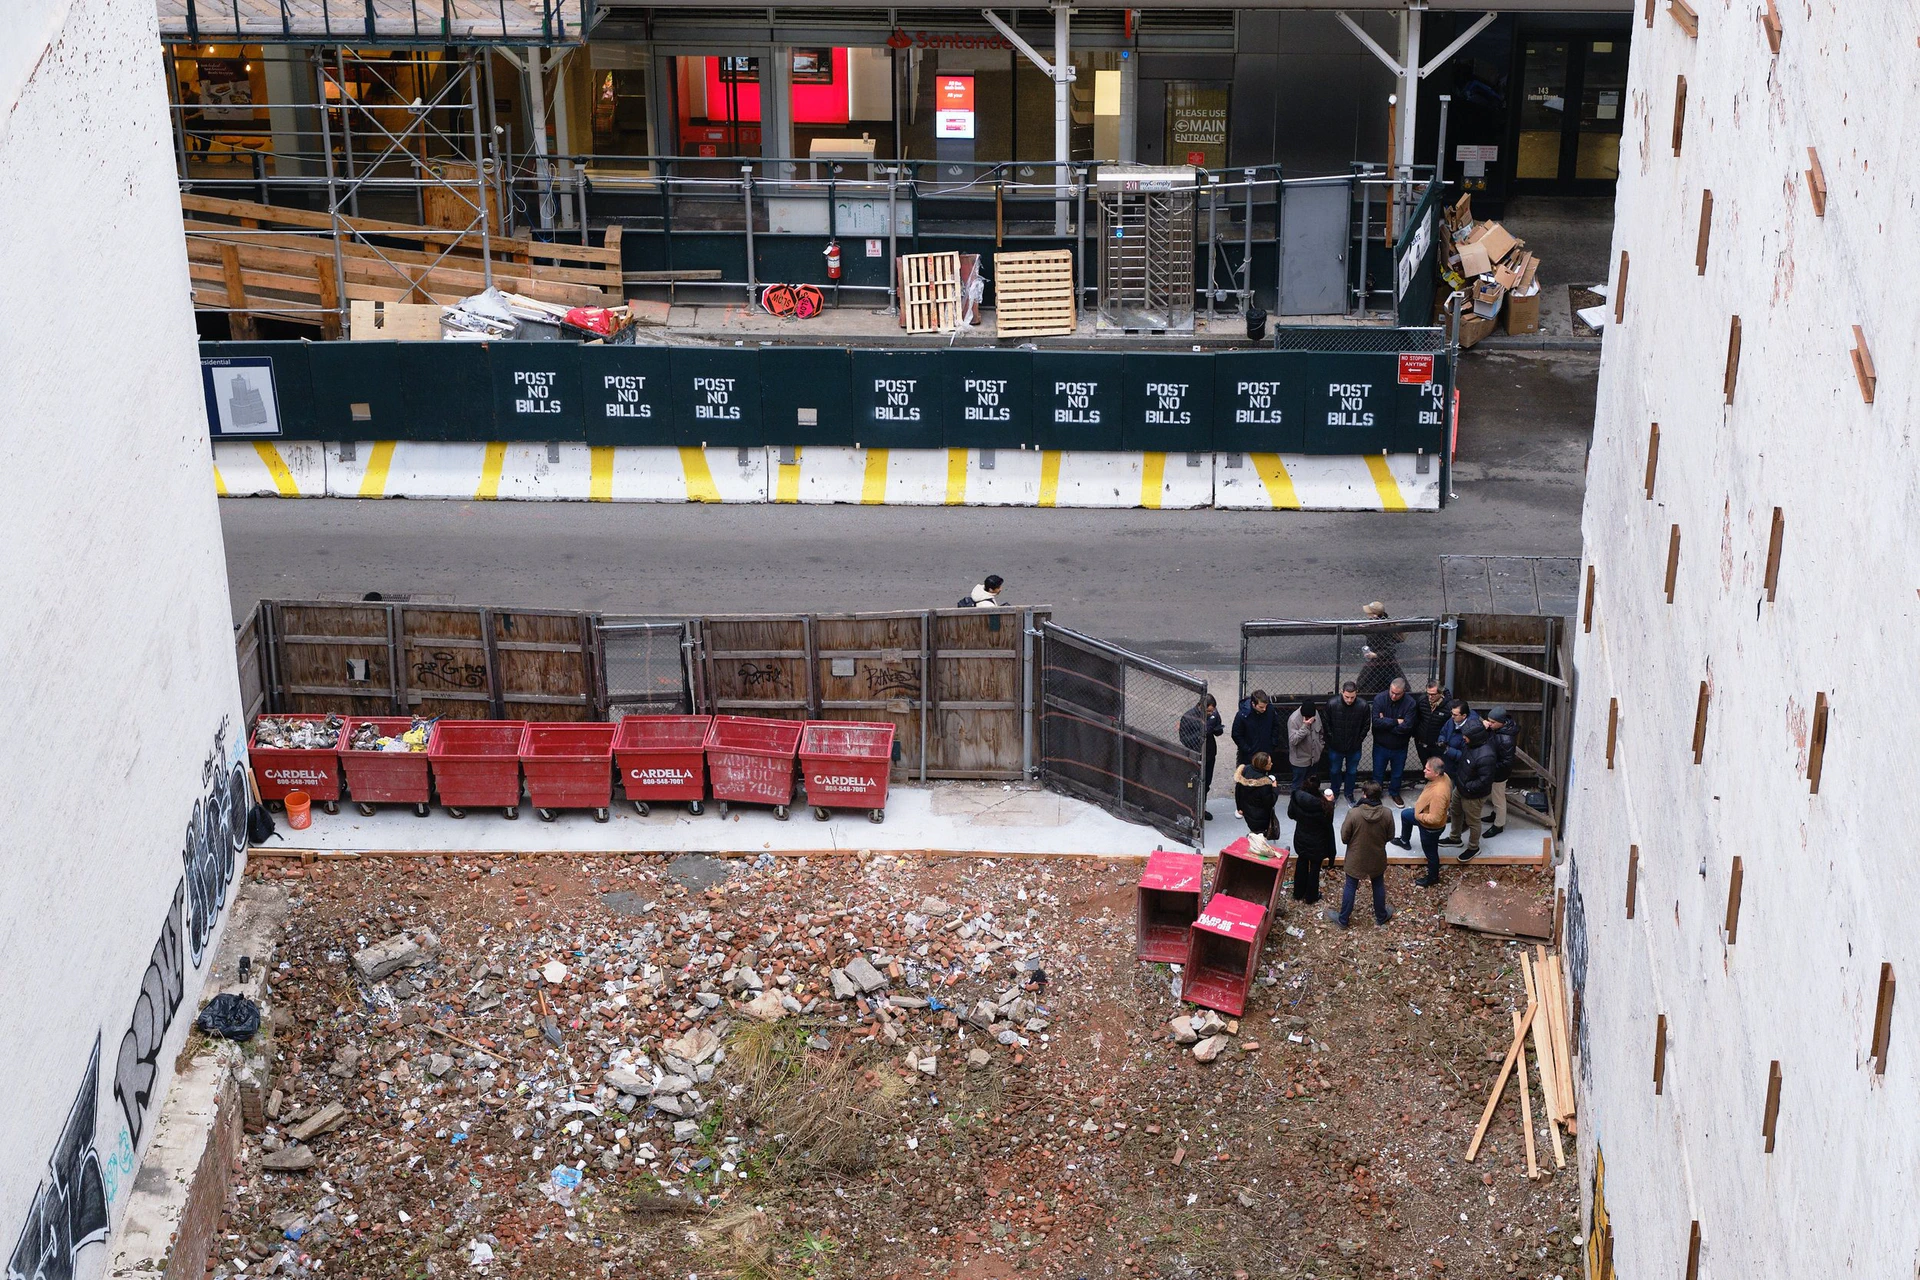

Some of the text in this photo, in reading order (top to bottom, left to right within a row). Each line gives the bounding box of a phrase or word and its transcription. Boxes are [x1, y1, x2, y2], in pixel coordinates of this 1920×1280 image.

[916, 32, 1012, 49] Santande
[1538, 87, 1549, 95] 143
[1190, 120, 1226, 132] MAIN
[1175, 134, 1225, 142] ENTRANCE
[515, 372, 555, 385] POST
[605, 376, 645, 389] POST
[694, 378, 735, 391] POST
[528, 386, 548, 398] NO
[875, 380, 916, 392] POST
[965, 380, 1007, 393] POST
[1056, 382, 1097, 395] POST
[1147, 383, 1188, 396] POST
[1238, 382, 1280, 395] POST
[1330, 384, 1371, 397] POST
[1420, 384, 1443, 396] PO
[618, 390, 638, 402] NO
[708, 392, 727, 404] NO
[888, 393, 908, 405] NO
[978, 393, 998, 405] NO
[1068, 396, 1088, 408] NO
[1250, 396, 1270, 408] NO
[516, 400, 560, 413] BILLS
[1159, 397, 1179, 409] NO
[1342, 398, 1362, 410] NO
[1432, 397, 1443, 410] N
[606, 404, 651, 417] BILLS
[696, 405, 740, 419] BILLS
[876, 407, 920, 420] BILLS
[965, 407, 1009, 420] BILLS
[1055, 410, 1100, 423] BILLS
[1236, 410, 1281, 423] BILLS
[1146, 411, 1190, 424] BILLS
[1328, 413, 1373, 425] BILLS
[1418, 411, 1443, 424] BIL
[265, 769, 328, 779] CARDELLA
[631, 769, 693, 778] CARDELLA
[814, 775, 876, 786] CARDELLA
